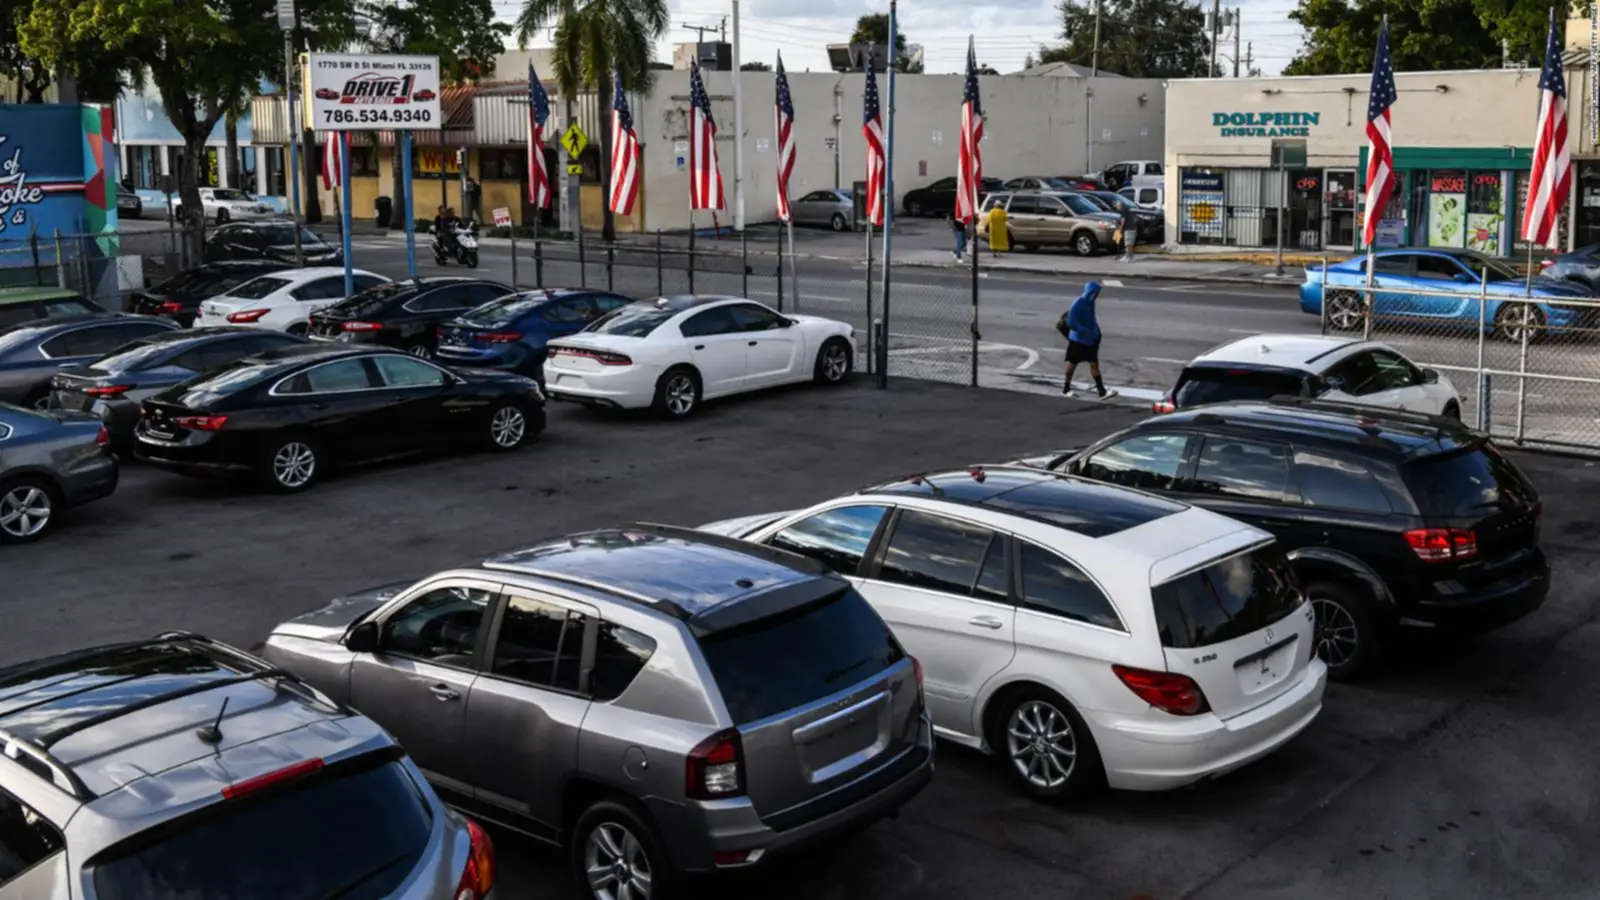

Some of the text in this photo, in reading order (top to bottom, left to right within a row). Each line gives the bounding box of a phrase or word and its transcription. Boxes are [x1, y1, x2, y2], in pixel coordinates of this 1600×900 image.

[323, 110, 431, 122] 786.534.9340
[1212, 112, 1320, 126] DOLPHIN
[1221, 127, 1309, 137] INSURANCE
[3, 148, 20, 175] of
[0, 173, 43, 204] oke
[1431, 177, 1465, 192] MASSAGE
[12, 209, 25, 224] &
